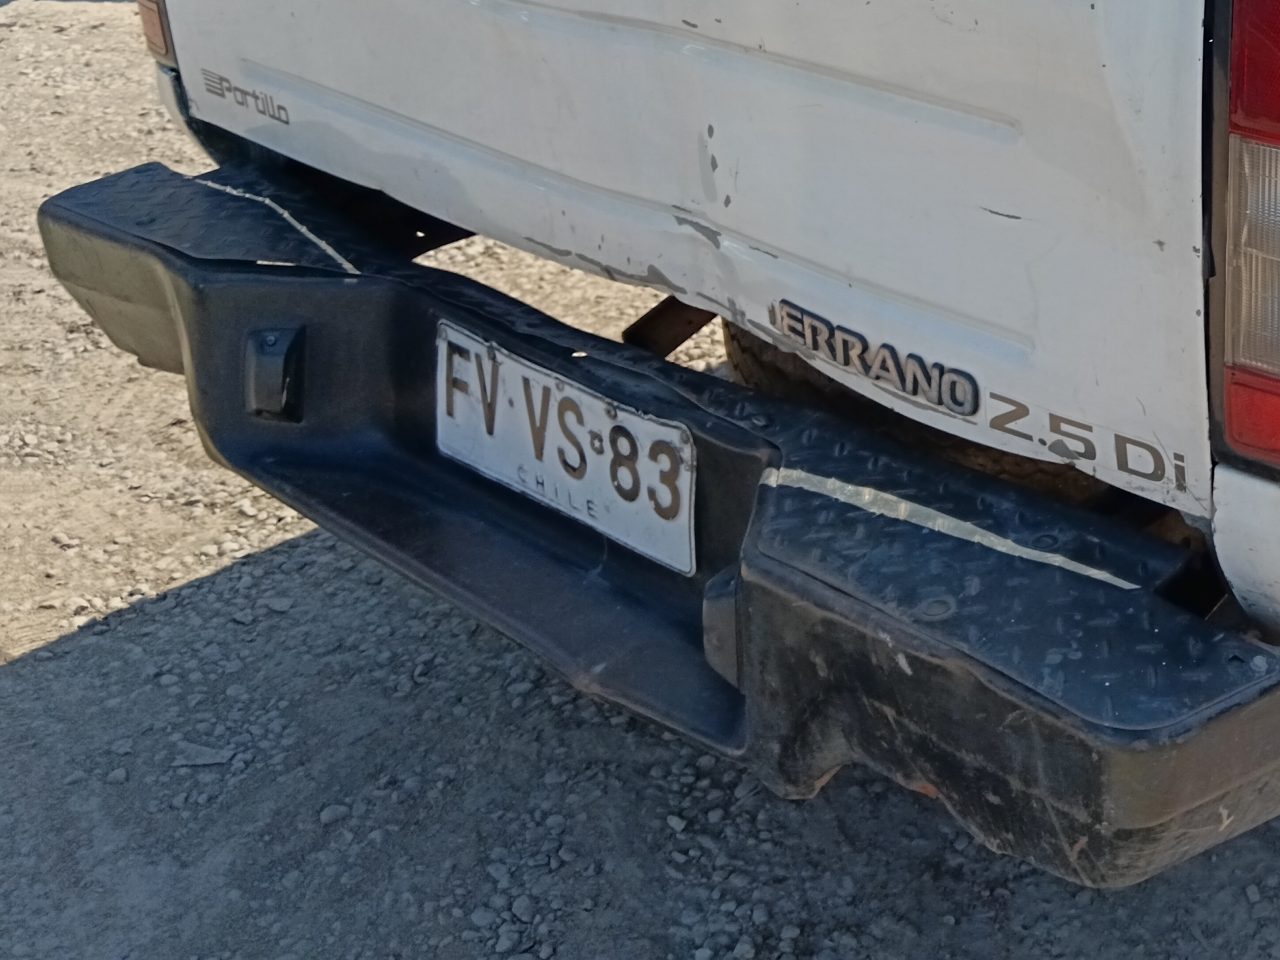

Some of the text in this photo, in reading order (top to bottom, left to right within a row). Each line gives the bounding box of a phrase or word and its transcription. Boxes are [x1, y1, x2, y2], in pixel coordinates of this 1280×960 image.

[989, 392, 1097, 461] 2.5
[1114, 433, 1188, 492] Di
[516, 464, 599, 518] CHILE
